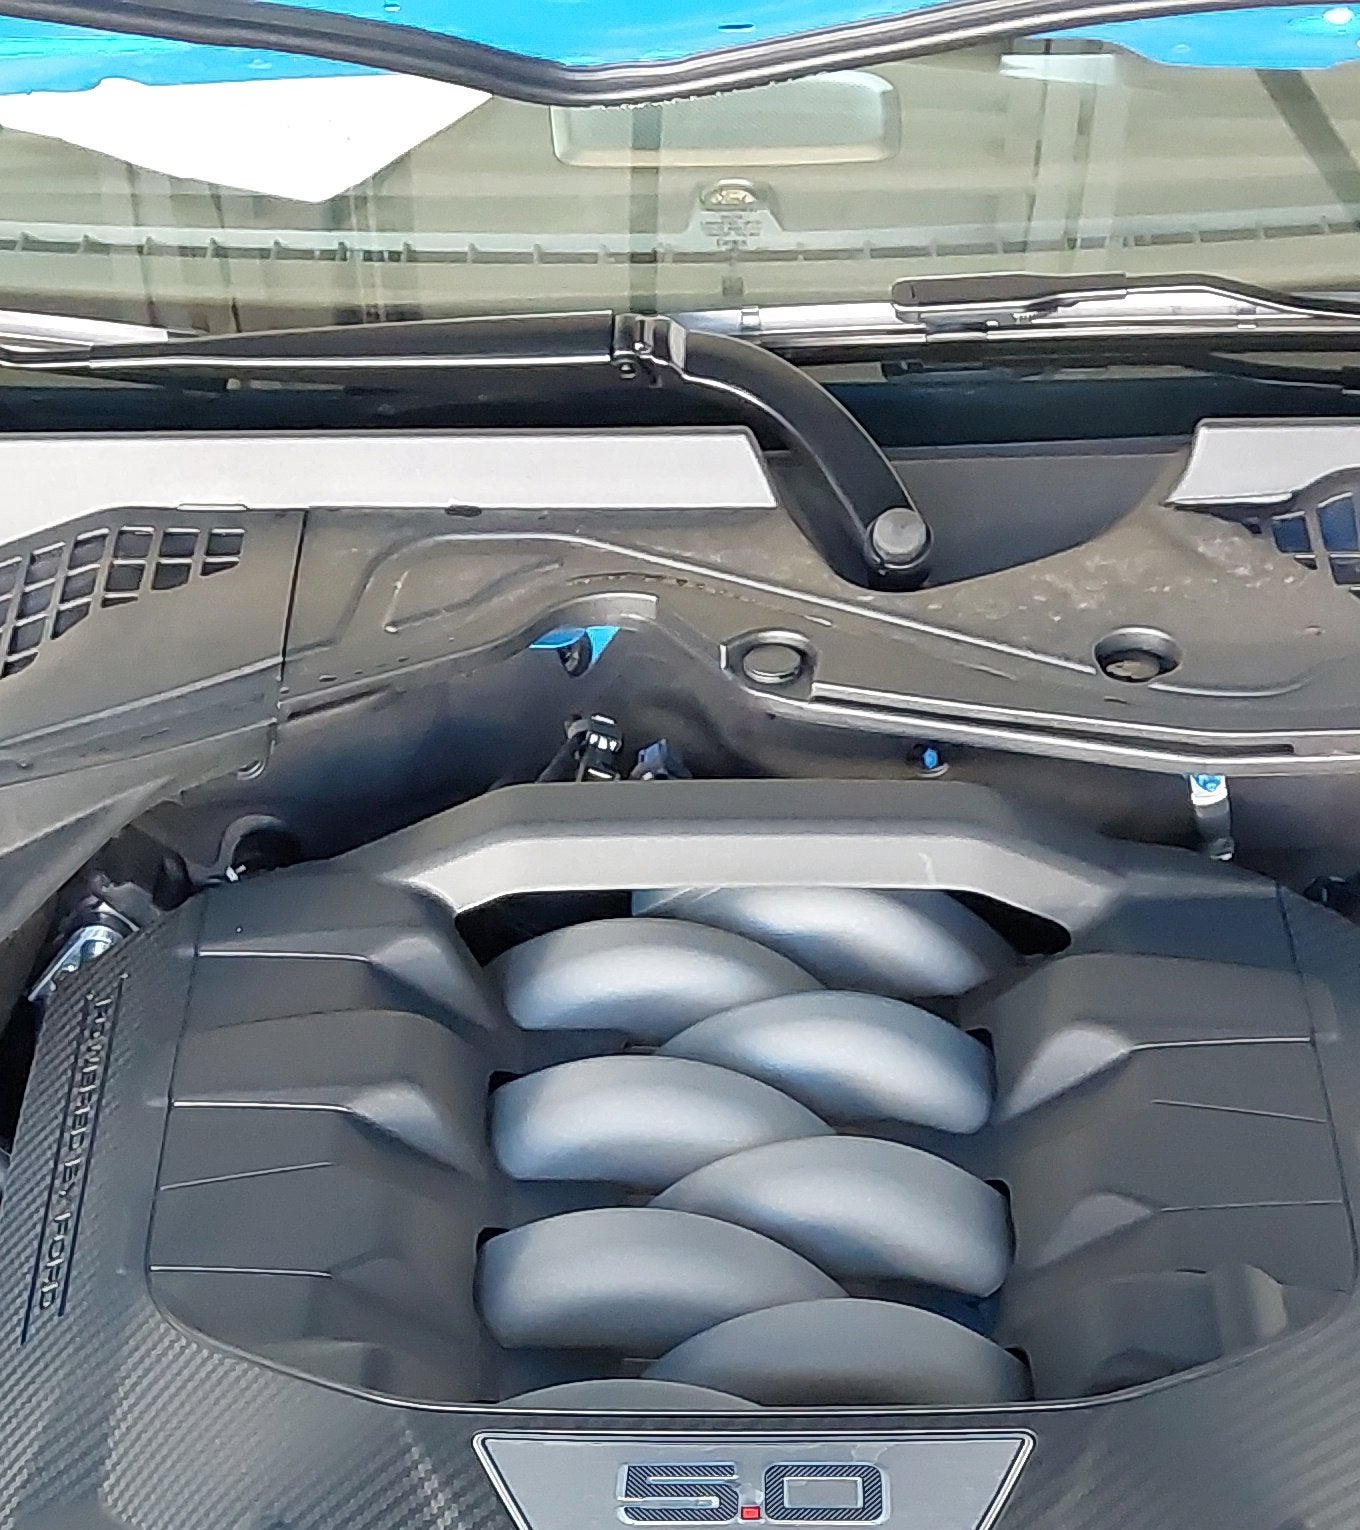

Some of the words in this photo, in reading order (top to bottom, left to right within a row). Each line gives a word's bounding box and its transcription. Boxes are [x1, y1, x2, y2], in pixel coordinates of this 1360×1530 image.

[57, 1157, 84, 1199] BY
[39, 1211, 73, 1310] FORD
[614, 1461, 890, 1526] 5.0
